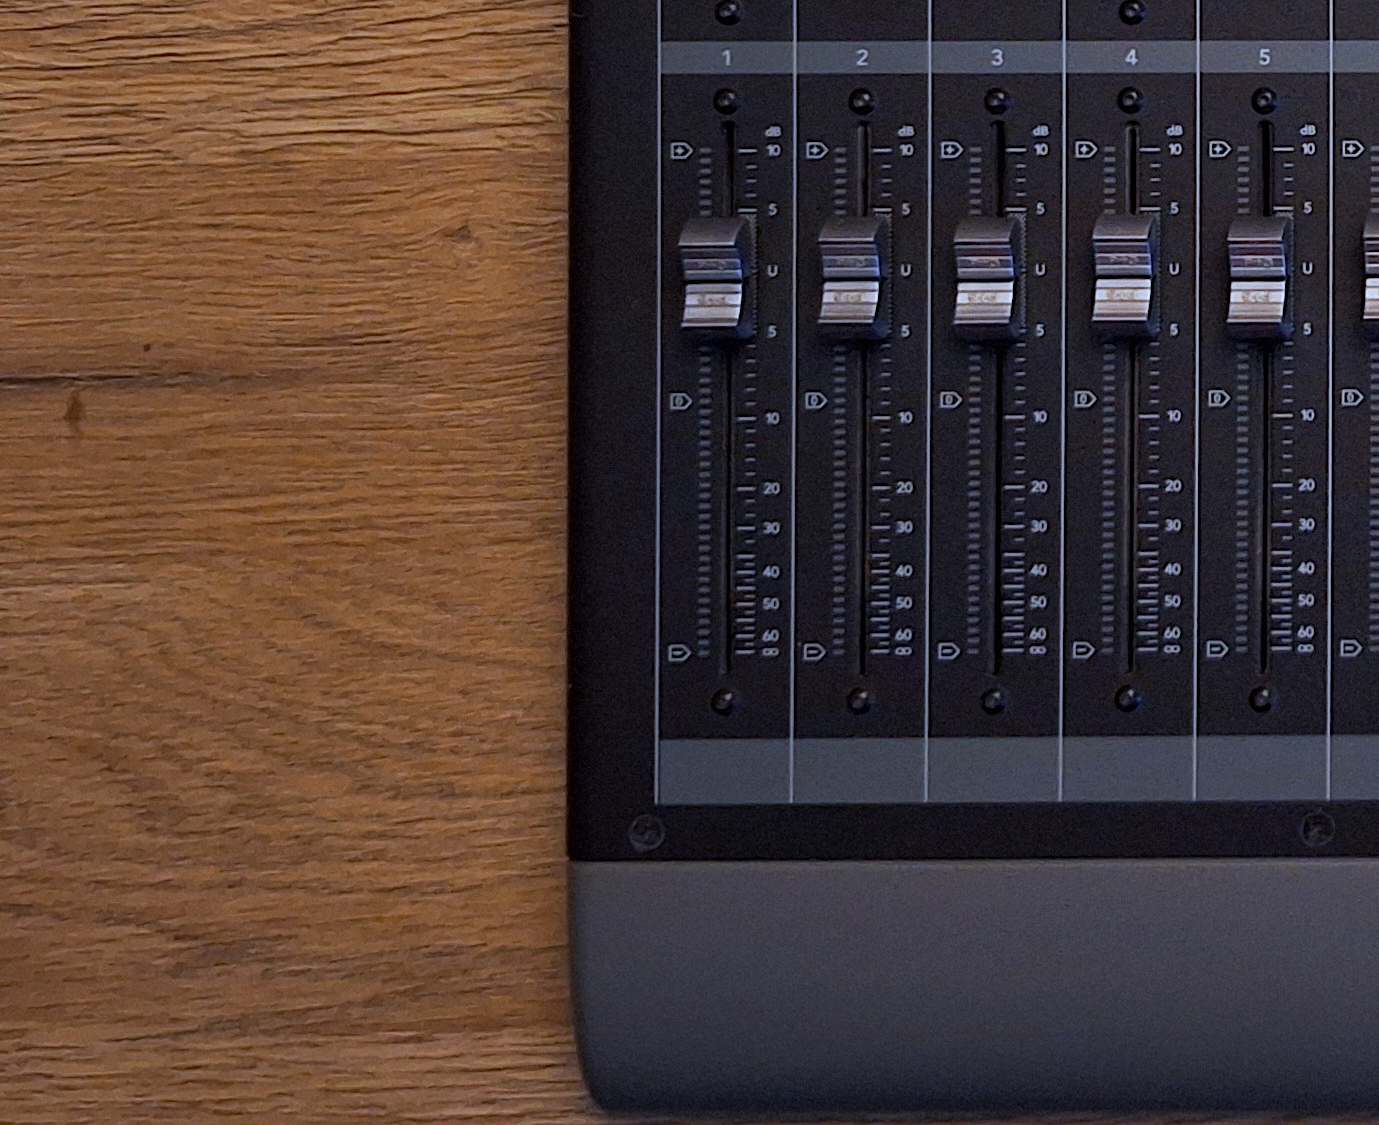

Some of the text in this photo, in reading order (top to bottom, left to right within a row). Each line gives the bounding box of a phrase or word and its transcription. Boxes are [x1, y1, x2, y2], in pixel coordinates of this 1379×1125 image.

[721, 49, 733, 66] 1
[856, 49, 869, 66] 2
[991, 49, 1004, 66] 3
[1125, 49, 1138, 65] 4
[1259, 49, 1271, 65] 5
